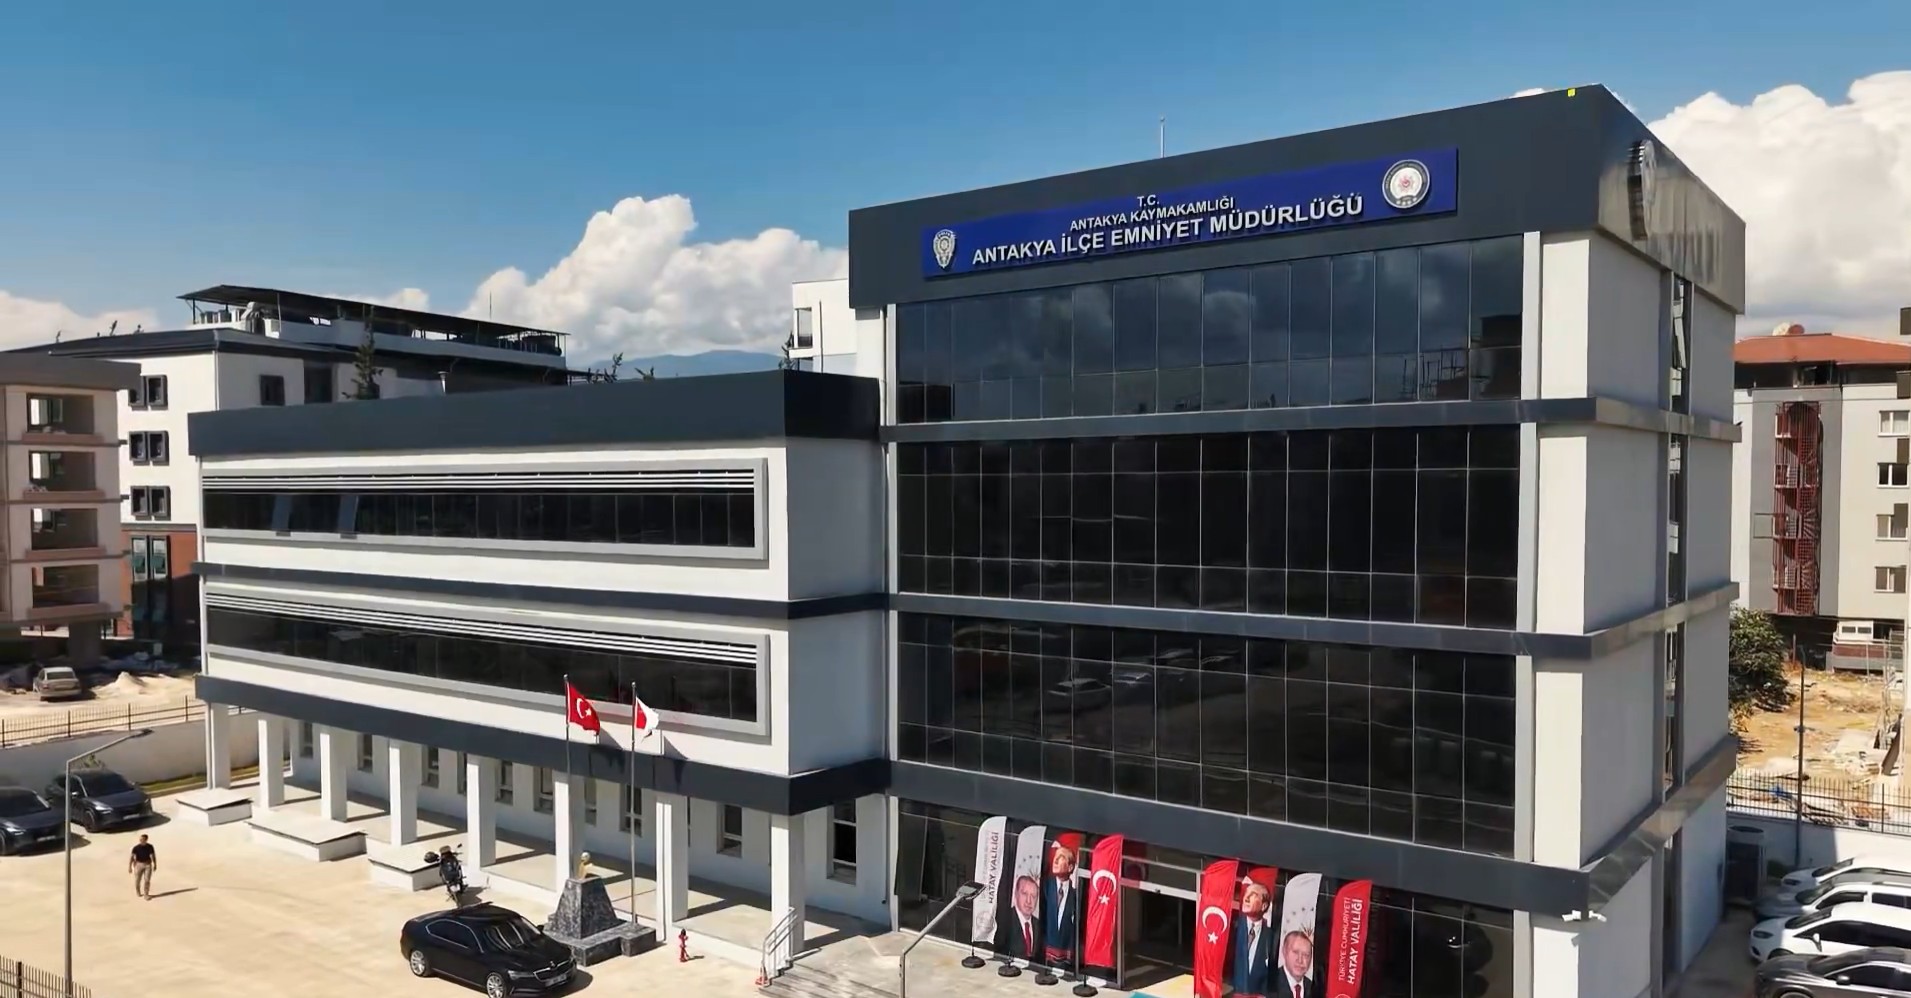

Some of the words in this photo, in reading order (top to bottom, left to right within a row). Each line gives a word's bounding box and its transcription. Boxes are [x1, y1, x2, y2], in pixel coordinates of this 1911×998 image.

[1070, 212, 1127, 231] ANTAKYA
[1130, 196, 1235, 221] KAYMAKAMLIĞI
[1137, 194, 1160, 207] T.C.
[972, 239, 1056, 265] ANTAKYA
[1061, 232, 1105, 254] İLÇE
[1111, 218, 1204, 247] EMNİYET
[1210, 192, 1363, 234] MÜDÜRLÜĞÜ
[988, 874, 998, 904] HATAY
[1350, 898, 1363, 945] VALİLİĞİ
[1347, 947, 1359, 985] HATAY
